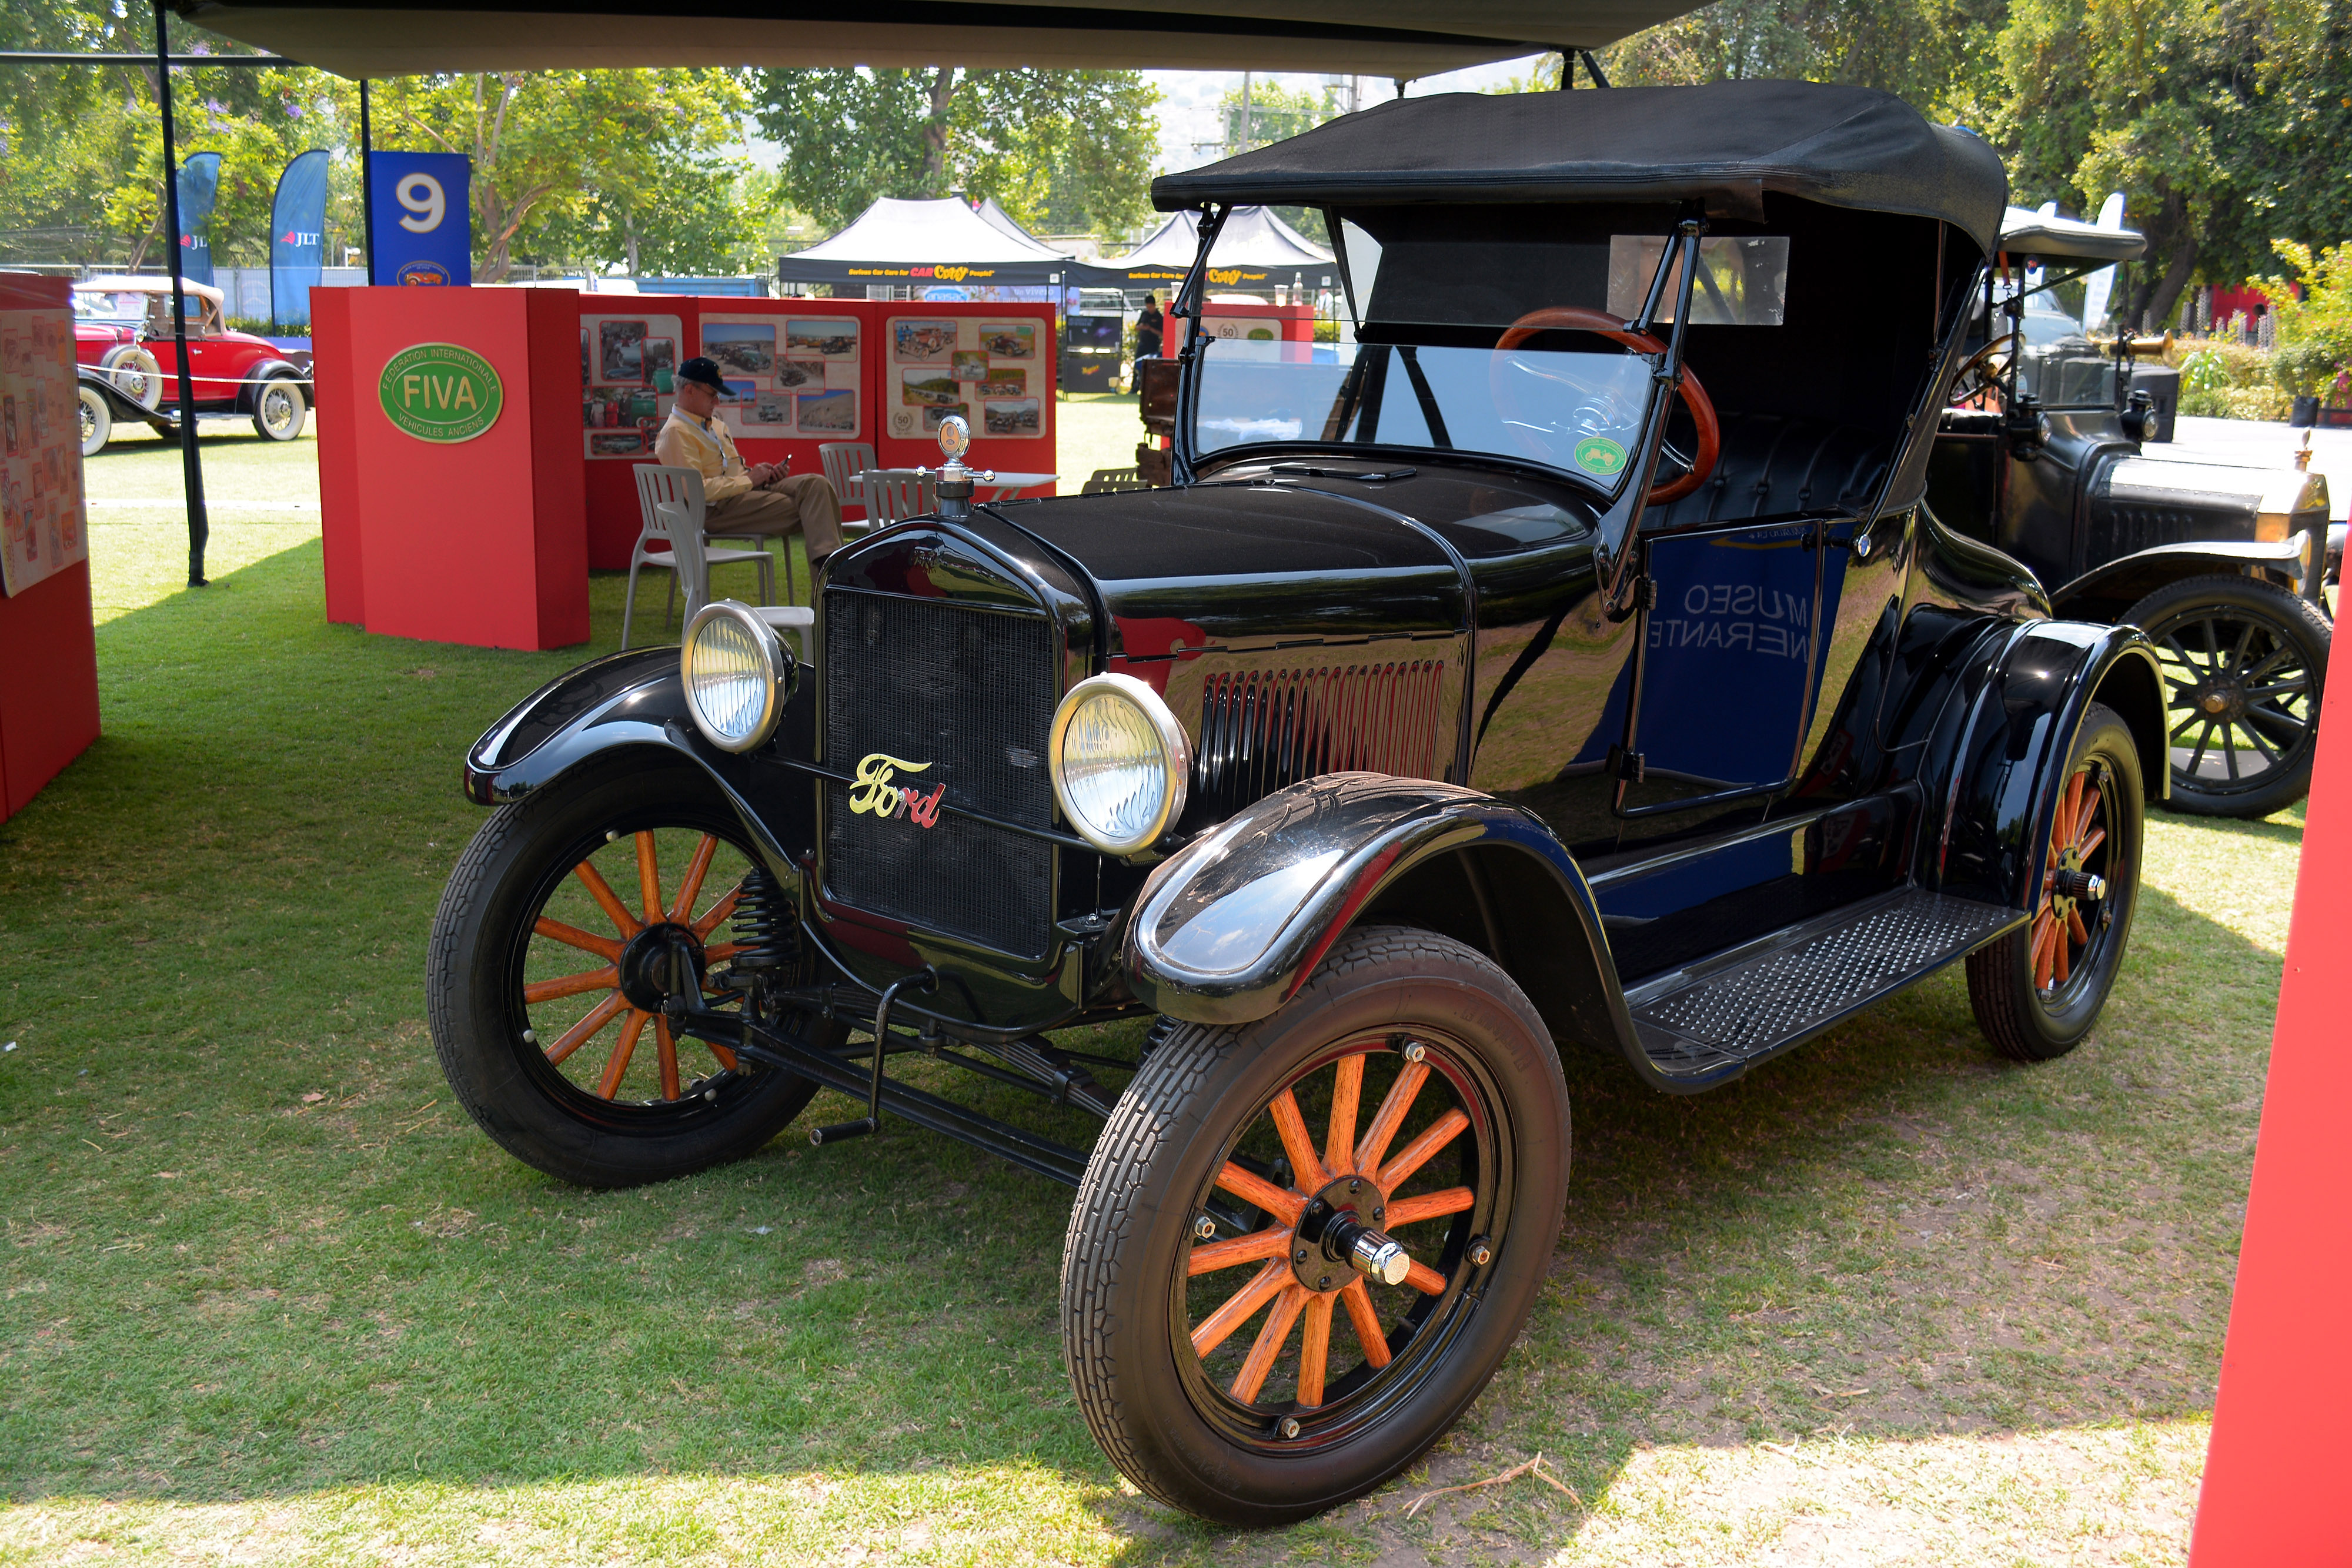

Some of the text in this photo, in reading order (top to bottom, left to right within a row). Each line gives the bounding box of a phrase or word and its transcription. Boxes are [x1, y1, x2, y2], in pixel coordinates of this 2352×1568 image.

[396, 172, 446, 233] 9
[192, 235, 208, 250] JL
[296, 232, 319, 248] JLT
[910, 268, 934, 277] CAR
[1222, 328, 1234, 336] 50
[383, 349, 497, 393] FEDERATION INTERNATIONALE
[403, 375, 477, 411] FIVA
[399, 413, 484, 437] VEHICULES ANCIENS
[849, 753, 946, 828] Ford
